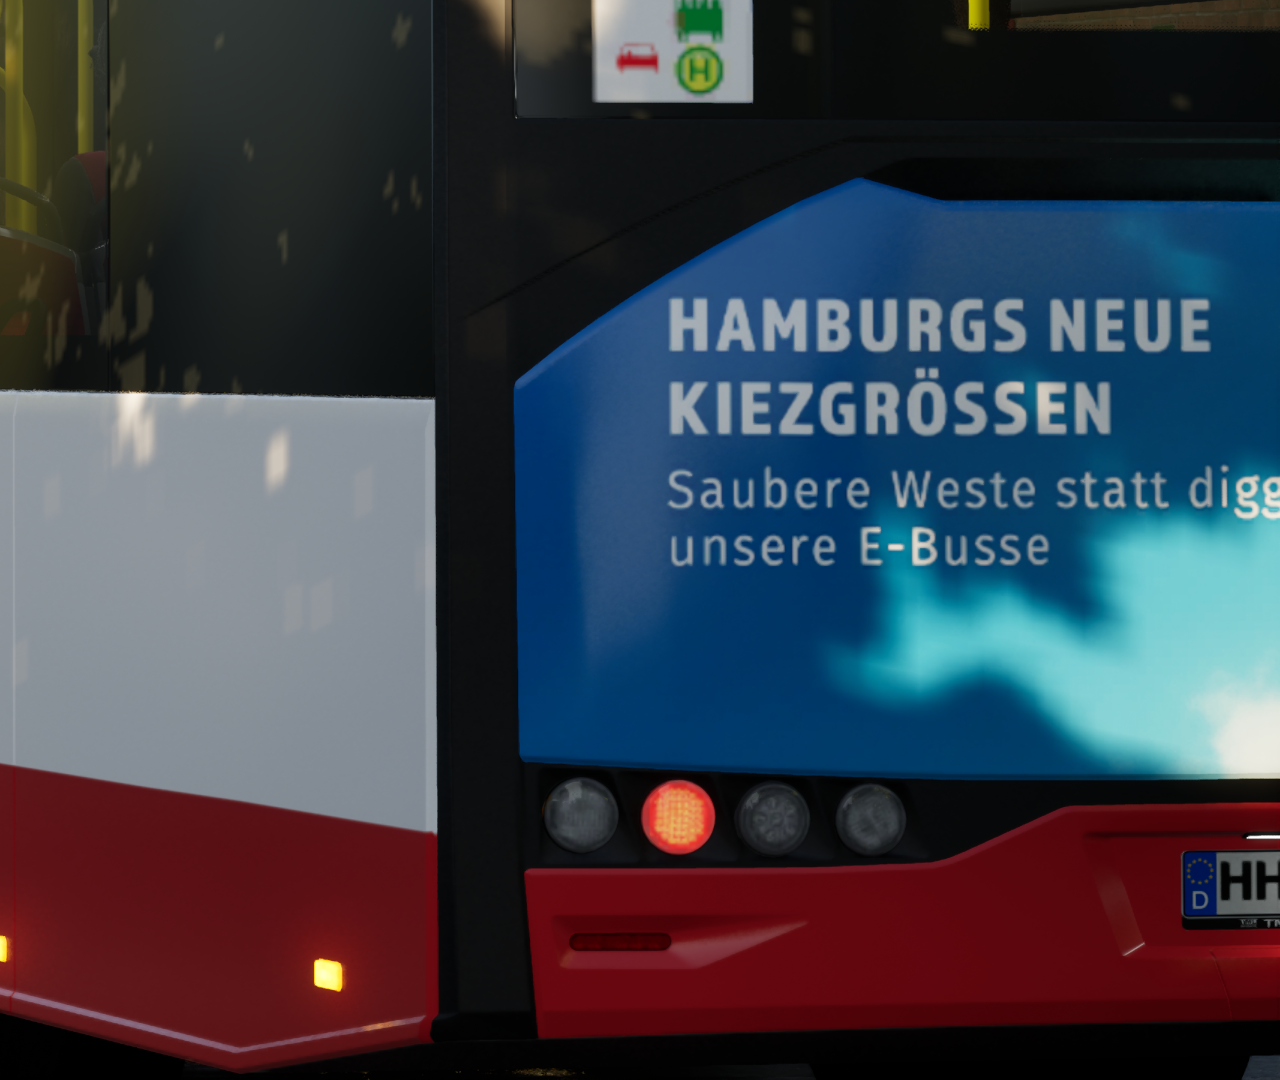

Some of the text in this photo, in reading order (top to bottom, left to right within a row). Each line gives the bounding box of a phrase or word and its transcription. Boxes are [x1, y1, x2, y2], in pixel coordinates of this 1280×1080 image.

[669, 297, 1211, 353] HAMBURGS NEUE
[669, 367, 1112, 436] KIEZGRÖSSEN
[667, 466, 870, 509] Saubere
[892, 470, 1035, 509] Weste
[1056, 472, 1169, 509] statt
[670, 526, 1049, 567] unsere E-Busse
[1192, 890, 1209, 910] D
